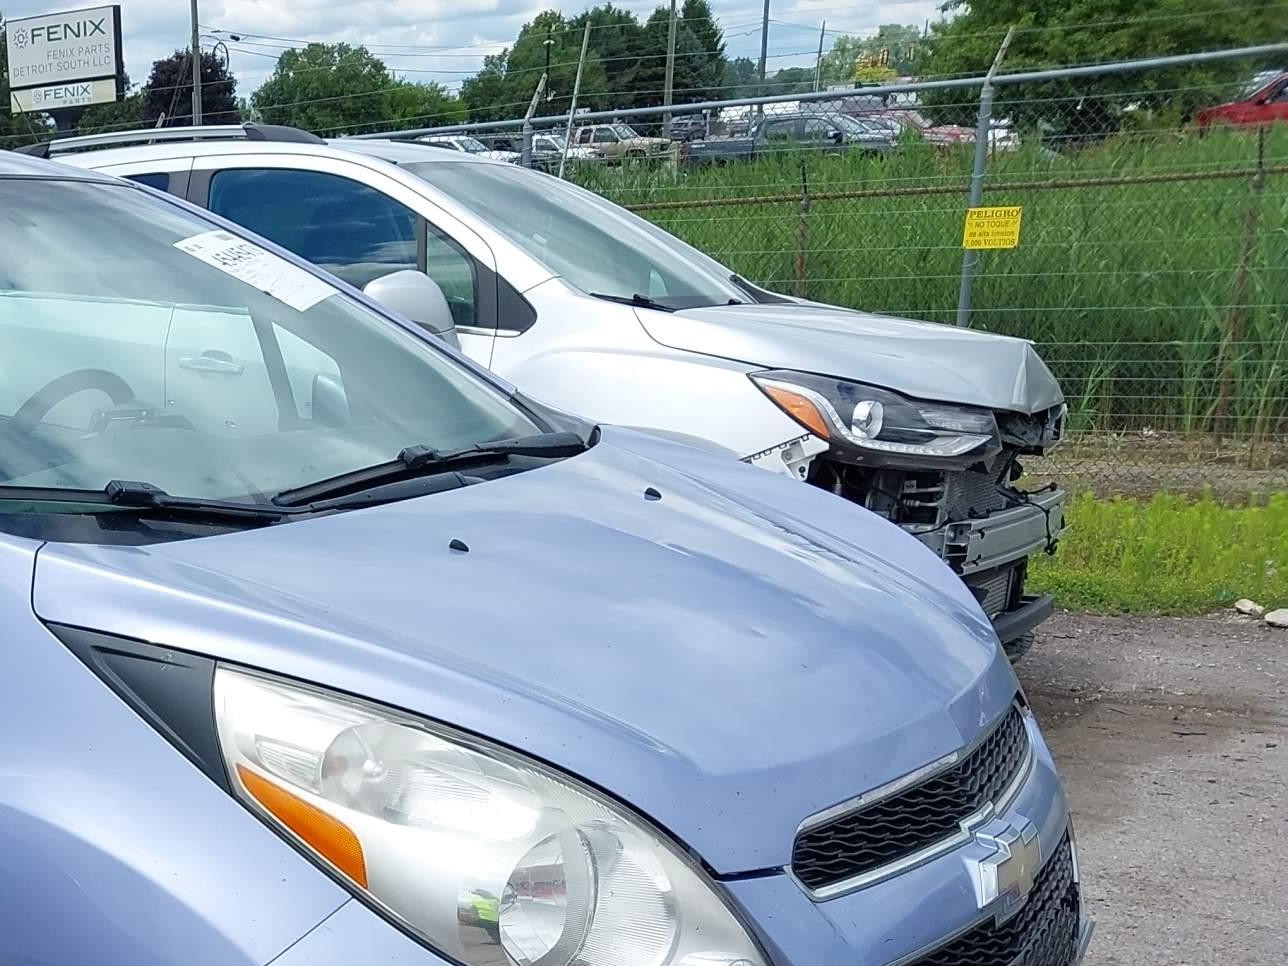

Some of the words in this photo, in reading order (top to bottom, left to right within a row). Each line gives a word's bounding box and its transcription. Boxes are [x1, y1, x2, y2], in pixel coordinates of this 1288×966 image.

[31, 17, 106, 45] FENIX
[46, 47, 75, 60] FENIX
[78, 42, 111, 56] PARTS
[13, 62, 54, 78] DETROIT
[57, 58, 90, 72] SOUTH
[92, 55, 111, 67] LLC
[43, 84, 91, 100] FENIX
[969, 209, 1019, 219] PELIGRO
[974, 221, 985, 229] NO
